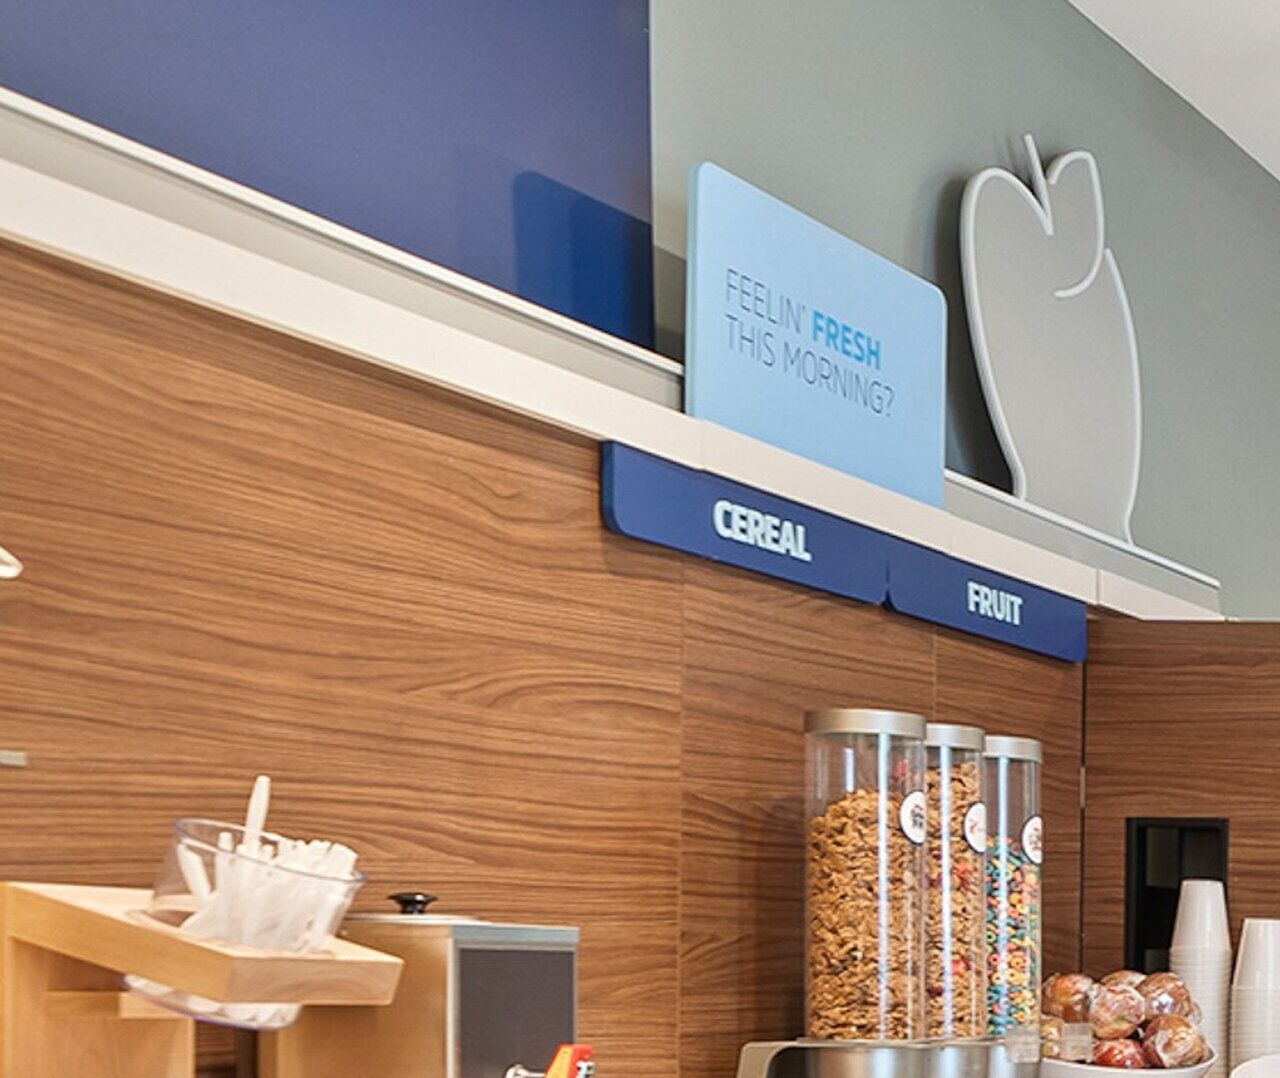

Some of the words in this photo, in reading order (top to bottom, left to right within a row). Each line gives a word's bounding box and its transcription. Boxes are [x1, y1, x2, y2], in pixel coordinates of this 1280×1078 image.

[726, 267, 805, 334] FEELIN'
[811, 309, 881, 371] FRESH
[725, 313, 776, 368] THIS
[784, 341, 895, 418] MORNING?
[713, 500, 812, 562] CEREAL
[967, 581, 1023, 626] FRUIT
